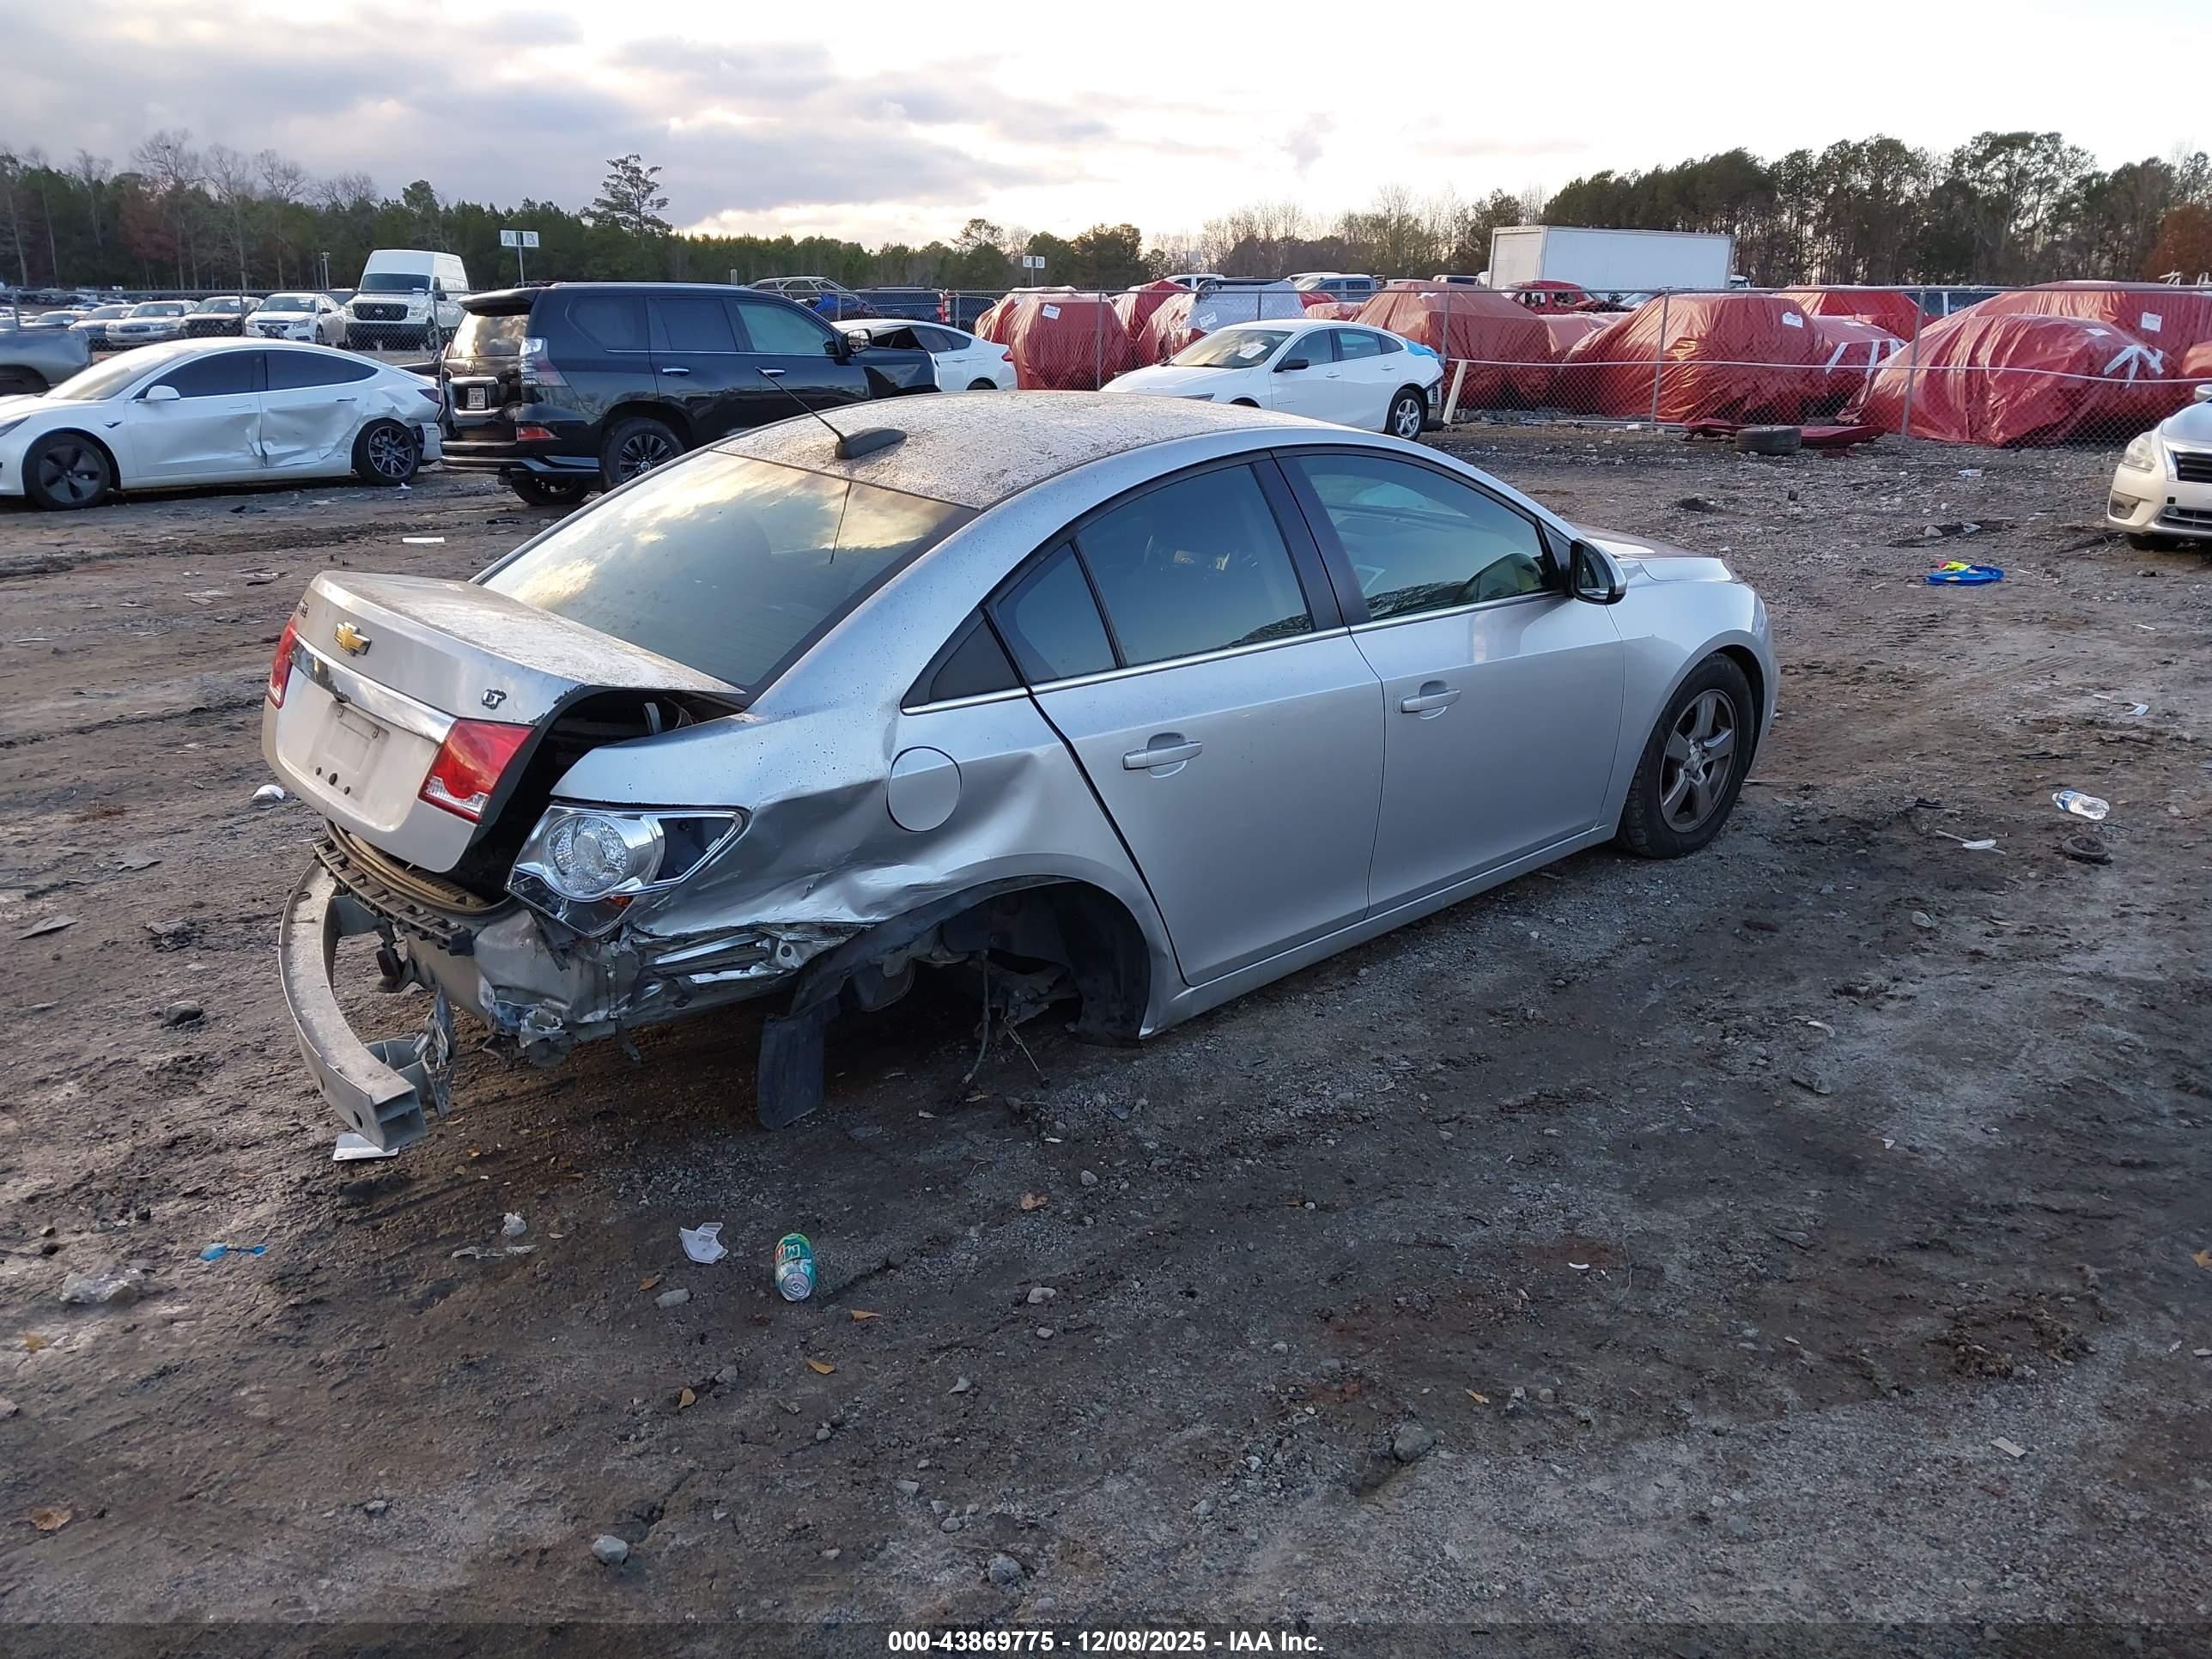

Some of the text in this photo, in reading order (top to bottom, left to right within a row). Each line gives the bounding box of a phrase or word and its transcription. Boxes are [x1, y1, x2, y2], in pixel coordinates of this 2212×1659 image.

[503, 232, 536, 245] A B
[1024, 257, 1043, 267] C D
[482, 690, 507, 709] LT
